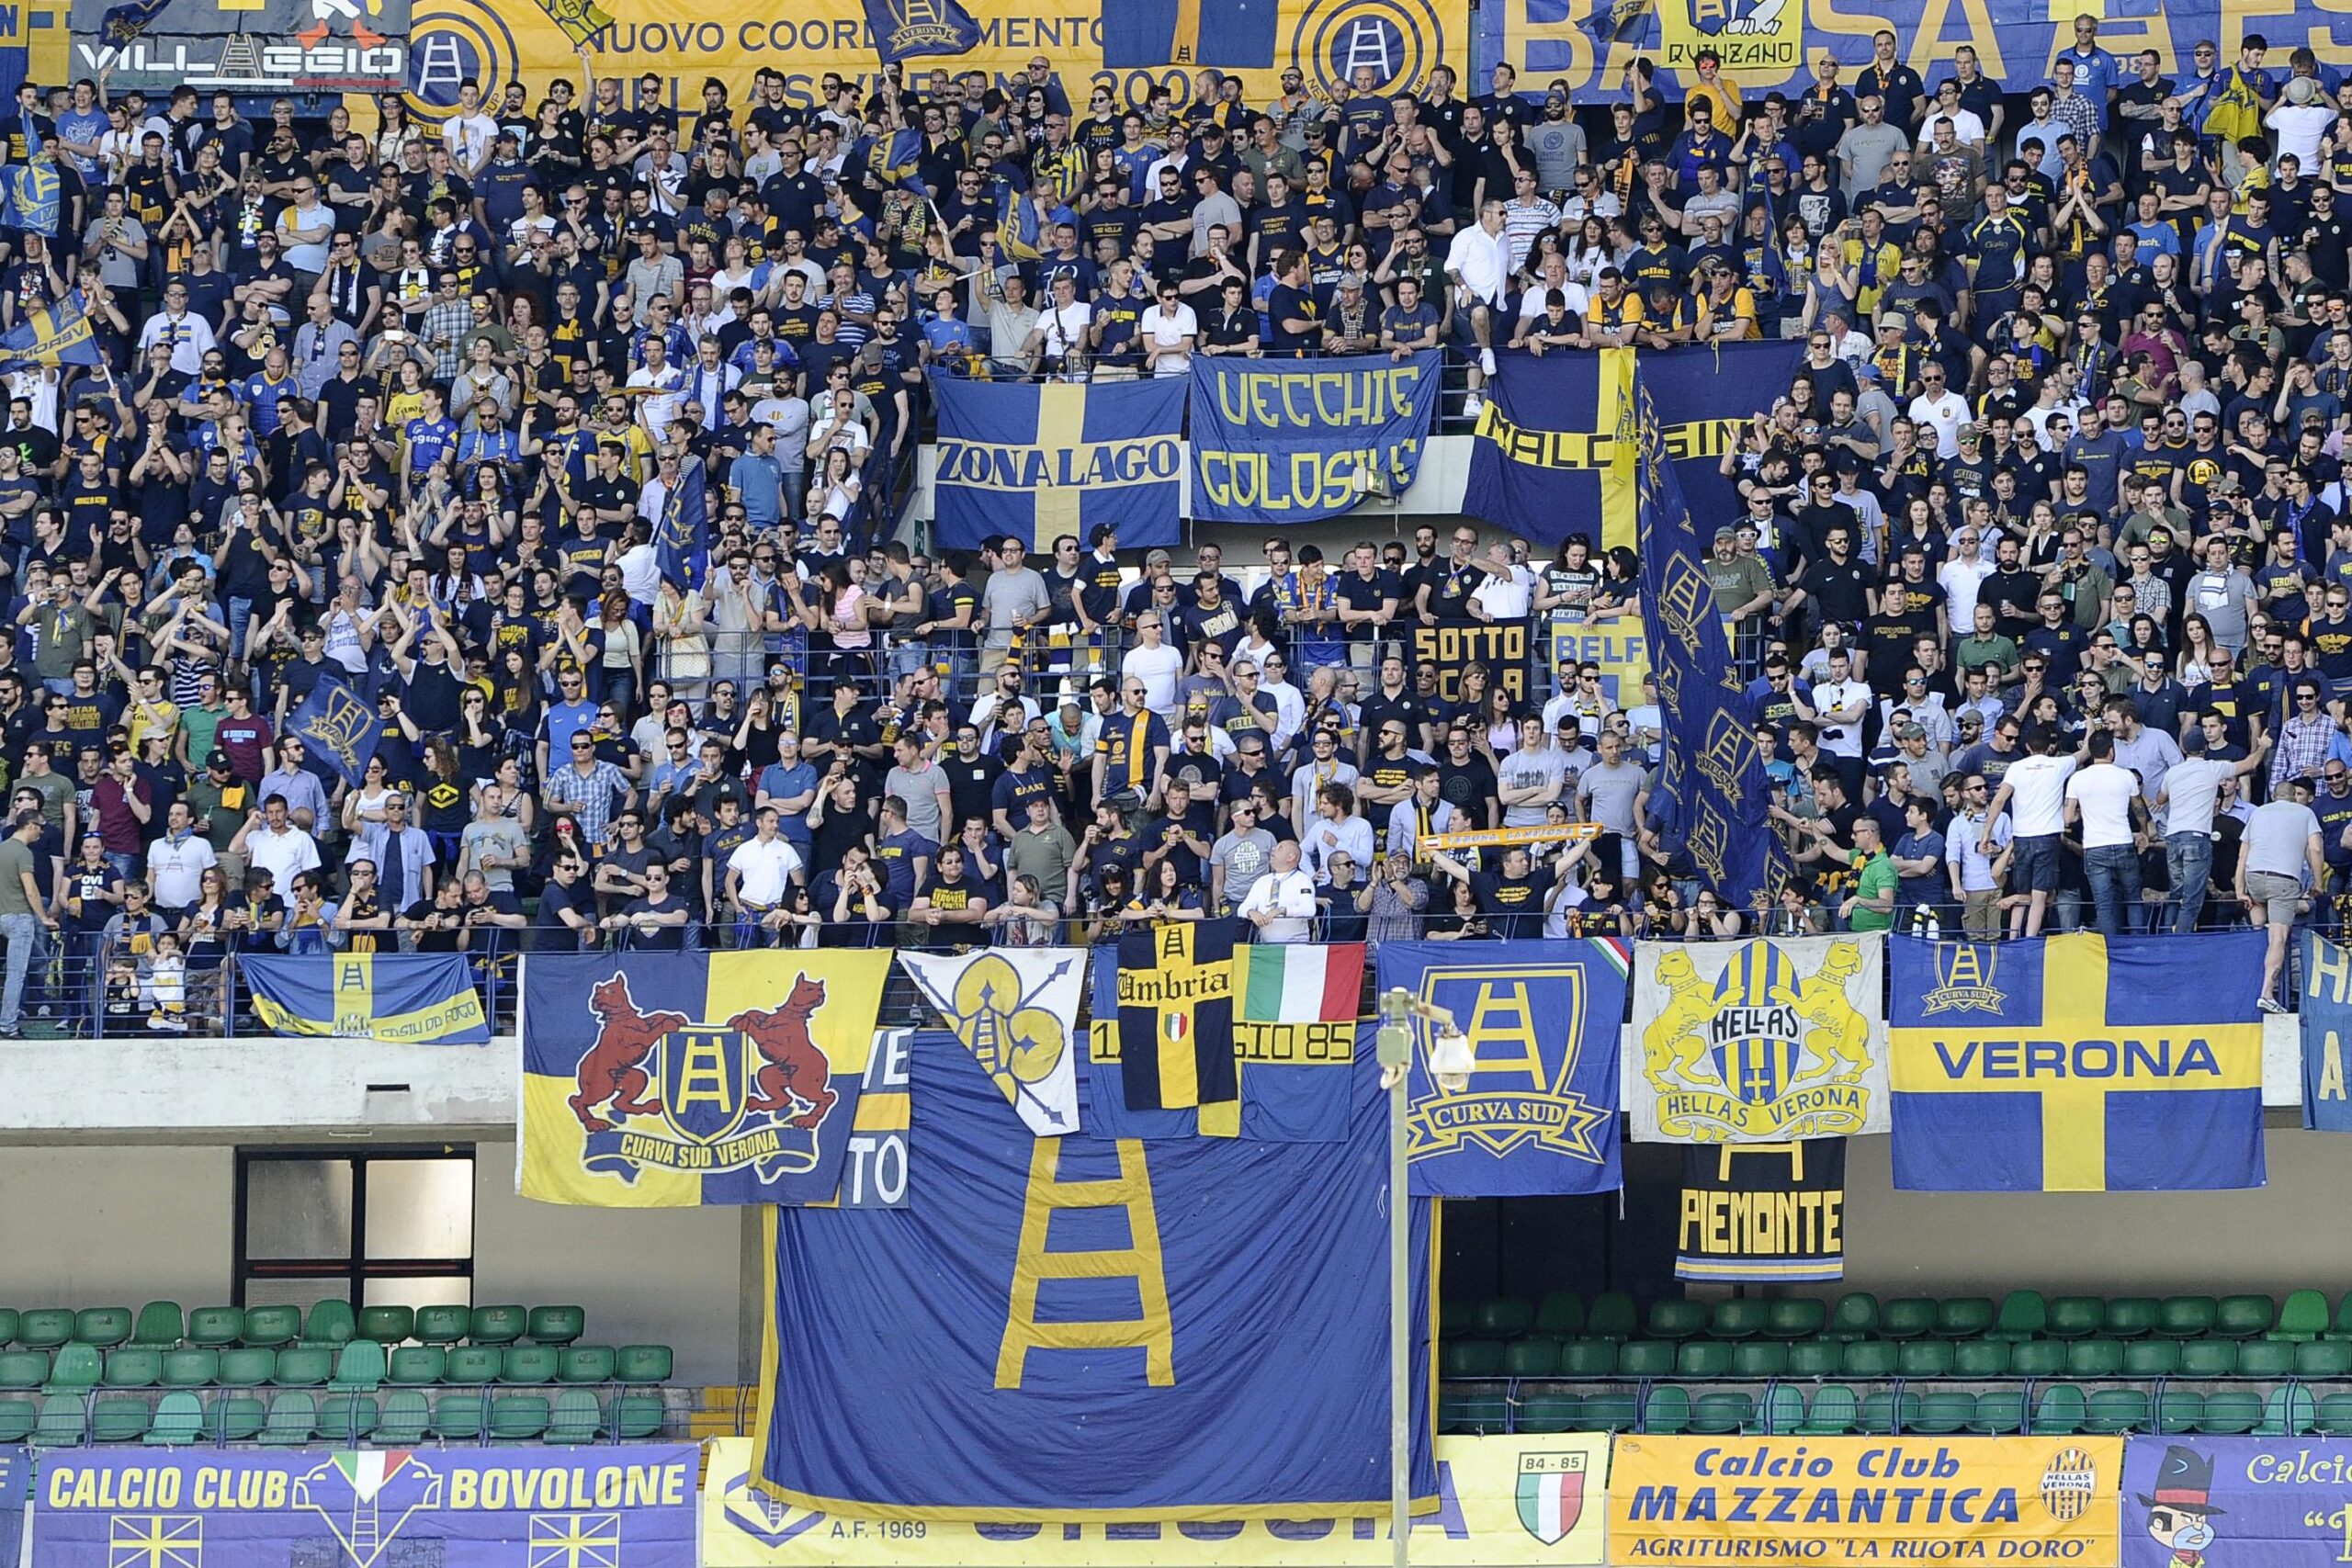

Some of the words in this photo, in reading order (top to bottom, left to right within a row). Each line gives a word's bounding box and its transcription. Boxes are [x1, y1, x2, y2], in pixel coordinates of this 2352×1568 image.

[903, 26, 944, 38] VERONA
[1415, 626, 1525, 661] SOTTO
[1556, 636, 1644, 664] BELF
[2309, 931, 2352, 1005] H
[1117, 969, 1230, 1002] Umbria
[1939, 991, 1969, 1001] CURVA
[1971, 991, 1989, 1001] SUD
[1712, 1005, 1800, 1044] HELLAS
[1306, 1023, 1352, 1060] 85
[1933, 1038, 2222, 1079] VERONA
[1434, 1101, 1512, 1127] CURVA
[1518, 1100, 1563, 1125] SUD
[1668, 1094, 1749, 1128] HELLAS
[1768, 1089, 1860, 1123] VERONA
[621, 1134, 673, 1164] CURVA
[678, 1146, 712, 1168] SUD
[716, 1130, 780, 1166] VERONA
[1678, 1190, 1843, 1255] PIEMONTE
[1526, 1457, 1545, 1470] 84
[1560, 1456, 1580, 1469] 85
[1694, 1447, 1831, 1479] Calcio
[1849, 1446, 1960, 1479] Club
[2047, 1472, 2091, 1482] HELLAS
[49, 1467, 181, 1508] CALCIO
[194, 1467, 287, 1508] CLUB
[450, 1464, 686, 1510] BOVOLONE
[2042, 1481, 2093, 1491] VERONA
[1628, 1487, 2020, 1525] MAZZANTICA
[831, 1520, 869, 1539] A.F.
[877, 1520, 927, 1540] 1969
[1630, 1538, 1826, 1560] AGRITURISMO
[1838, 1538, 1890, 1560] "LA
[1896, 1539, 1989, 1559] RUOTA
[1997, 1538, 2097, 1559] DORO"
